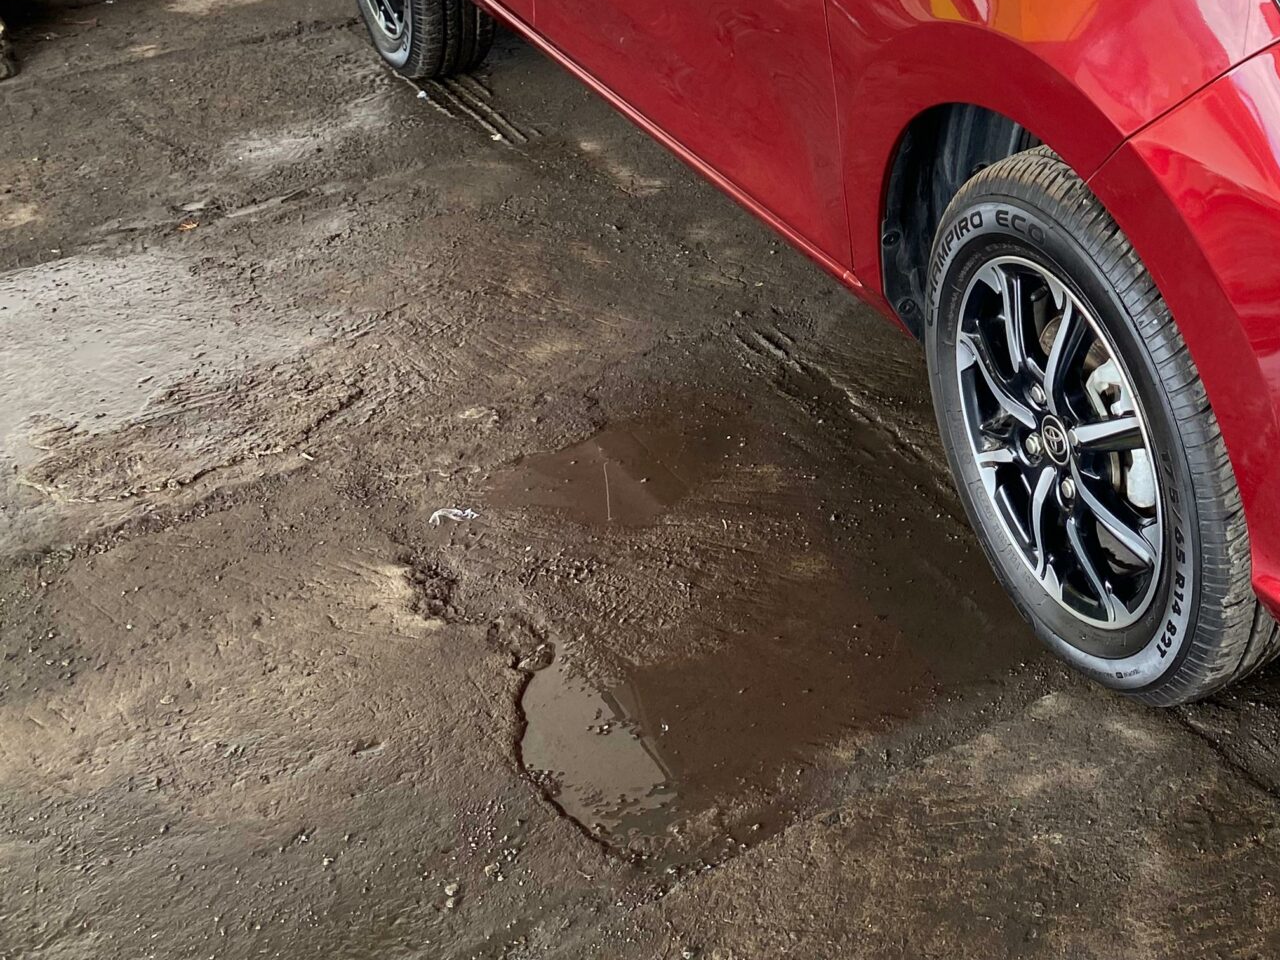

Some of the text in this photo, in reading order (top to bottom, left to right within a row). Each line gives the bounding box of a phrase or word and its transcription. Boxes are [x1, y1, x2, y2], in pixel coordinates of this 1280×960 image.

[926, 210, 984, 327] CHAMPIRO
[995, 210, 1046, 245] ECO
[1171, 573, 1186, 617] R14
[1156, 618, 1177, 659] 82T
